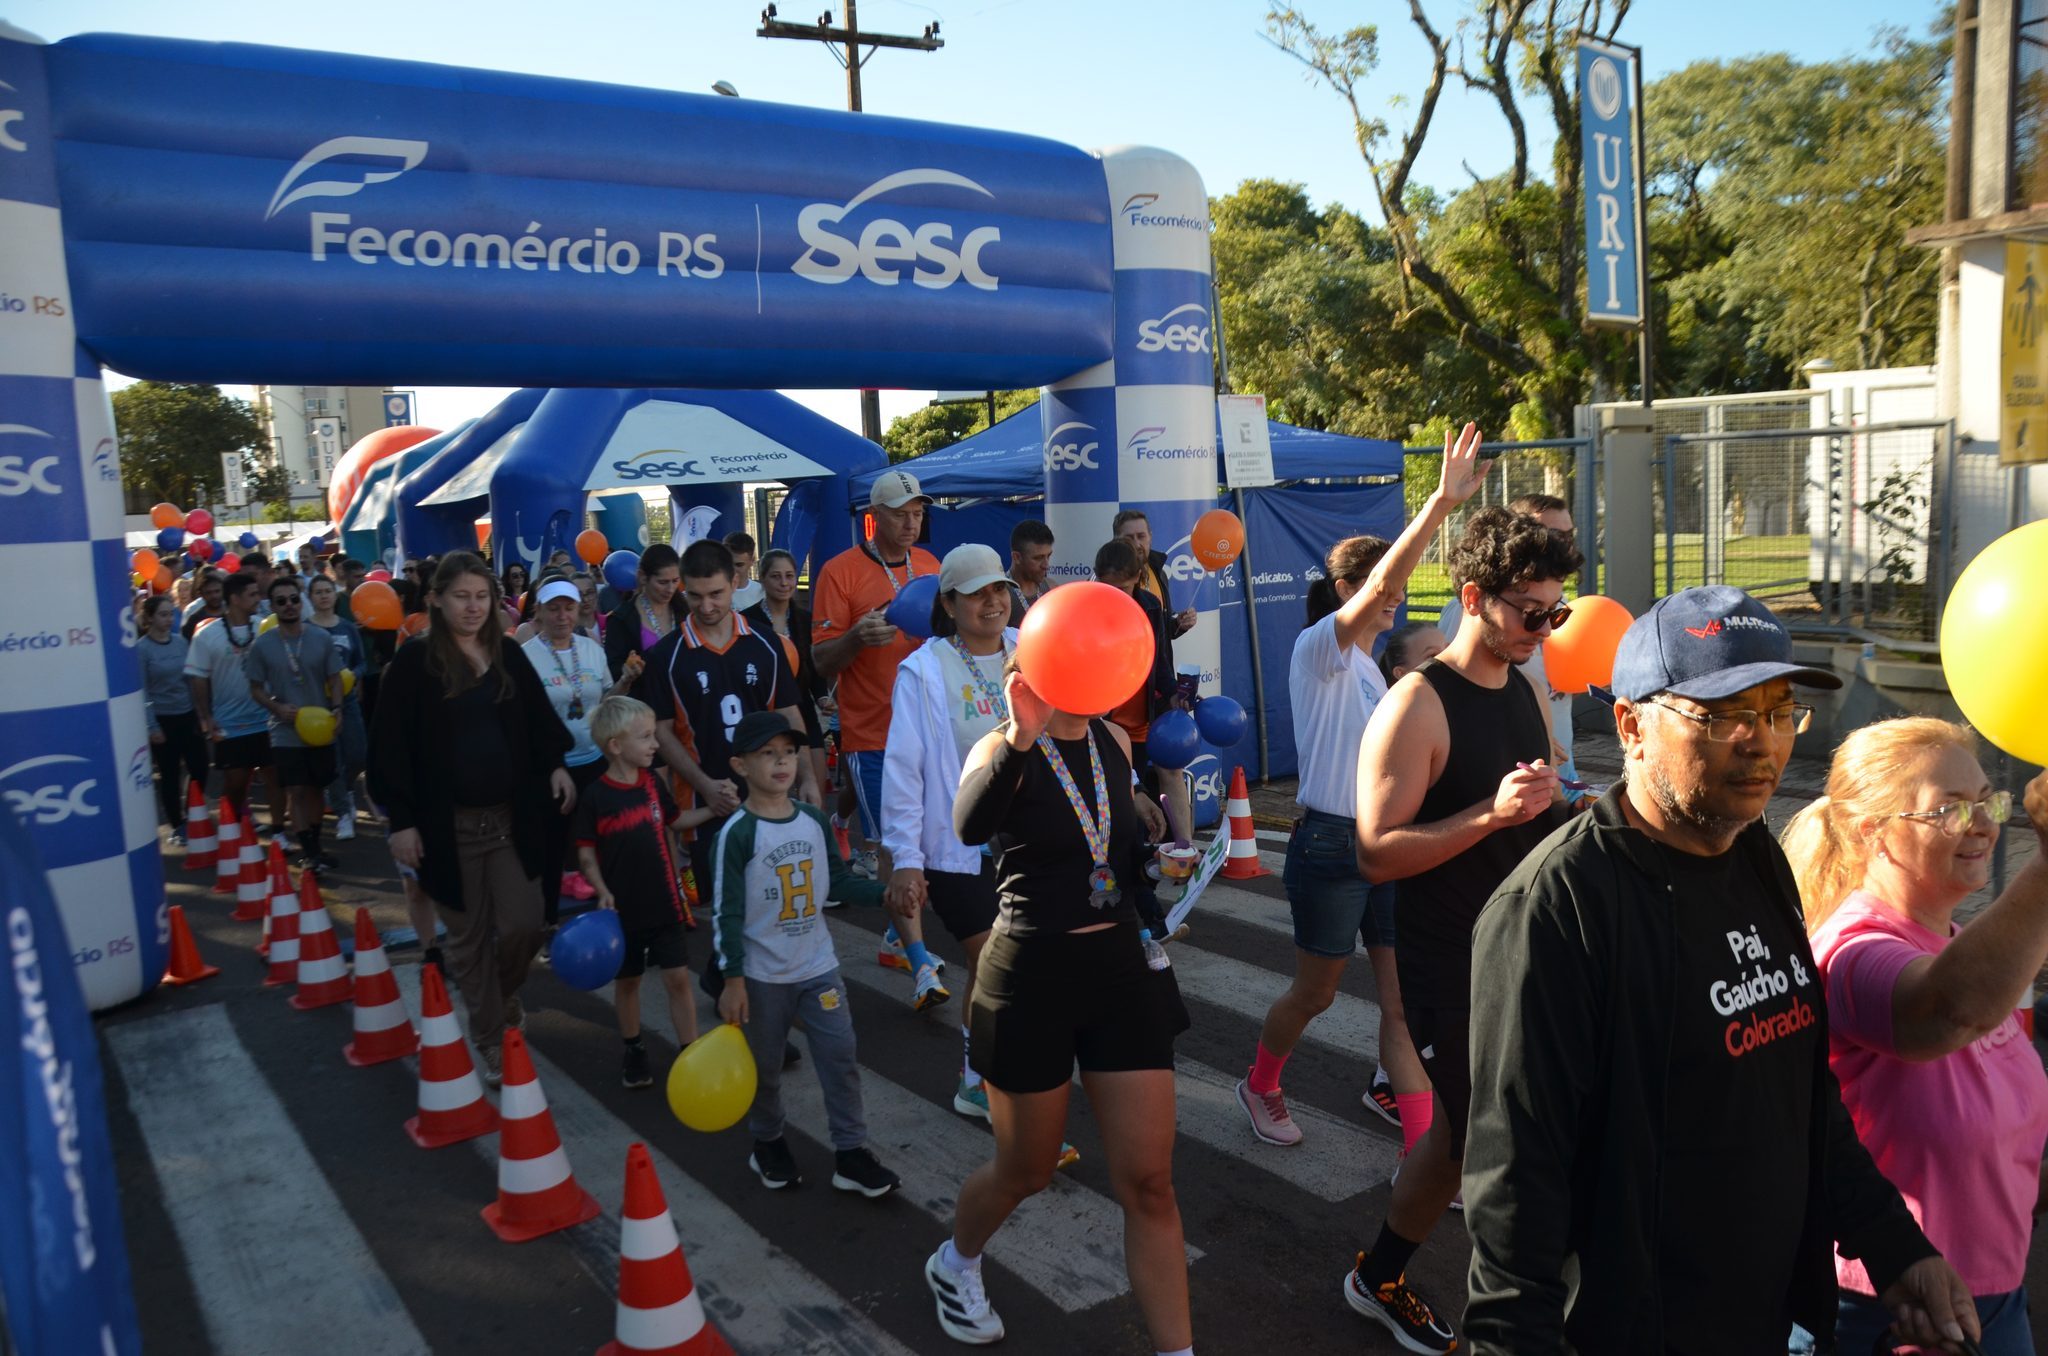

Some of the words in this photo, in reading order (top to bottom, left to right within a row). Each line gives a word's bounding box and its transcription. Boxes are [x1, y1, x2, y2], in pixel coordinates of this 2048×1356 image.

[790, 168, 1001, 291] Sesc
[1130, 213, 1202, 231] Fecomércio
[1593, 132, 1625, 310] URI
[311, 211, 640, 275] Fecomércio
[657, 231, 725, 279] RS
[32, 295, 65, 316] RS
[1136, 303, 1209, 354] Sesc
[613, 449, 705, 480] Sesc
[711, 452, 788, 464] Fecomércio
[1136, 445, 1207, 460] Fecomércio
[1251, 572, 1294, 585] ndicatos
[67, 627, 97, 647] RS
[764, 887, 779, 901] 19
[776, 858, 817, 921] H
[107, 937, 135, 958] RS
[1726, 923, 1771, 965] Pai,
[1710, 964, 1789, 1006] Gaúcho
[1790, 953, 1811, 987] &
[1725, 996, 1816, 1057] Colorado.
